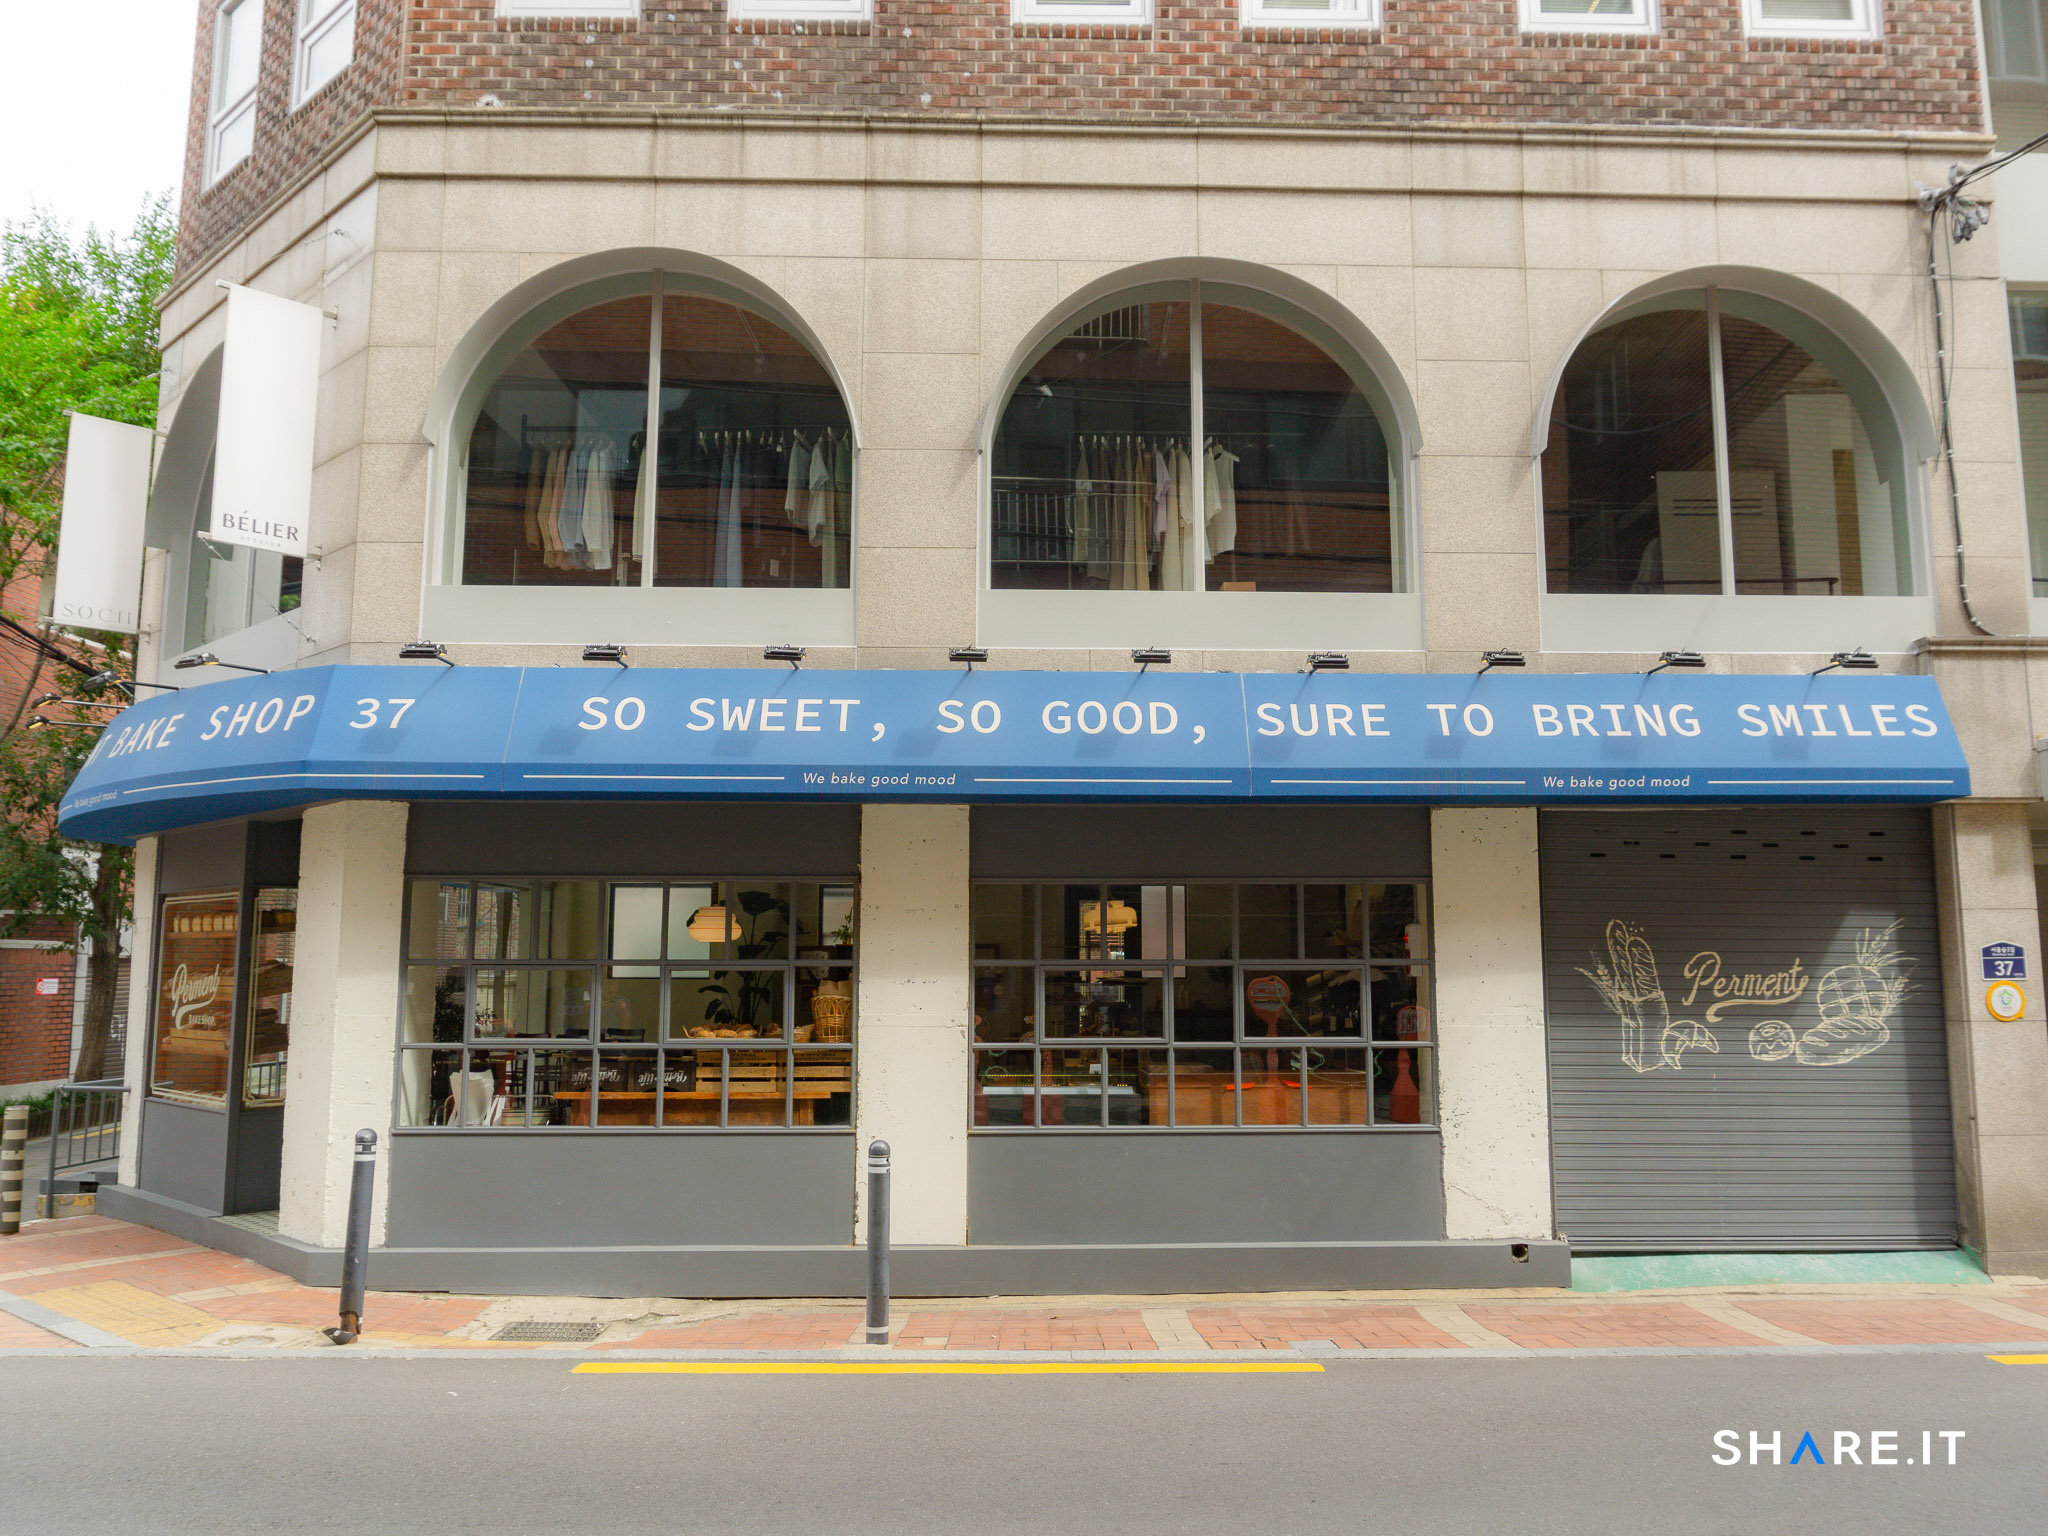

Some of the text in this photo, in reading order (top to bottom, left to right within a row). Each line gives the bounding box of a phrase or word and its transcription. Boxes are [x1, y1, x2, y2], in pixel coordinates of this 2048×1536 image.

[222, 510, 298, 541] BÉLIER
[62, 603, 131, 625] SOCII
[107, 713, 185, 759] BAKE
[200, 694, 316, 741] SHOP
[349, 697, 416, 730] 37
[578, 697, 1938, 745] SO SWEET, SO GOOD, SURE TO BRING SMILES
[803, 772, 956, 787] We bake good mood
[1543, 775, 1690, 790] We bake good mood
[1994, 961, 2014, 976] 37
[172, 963, 220, 1030] Perment
